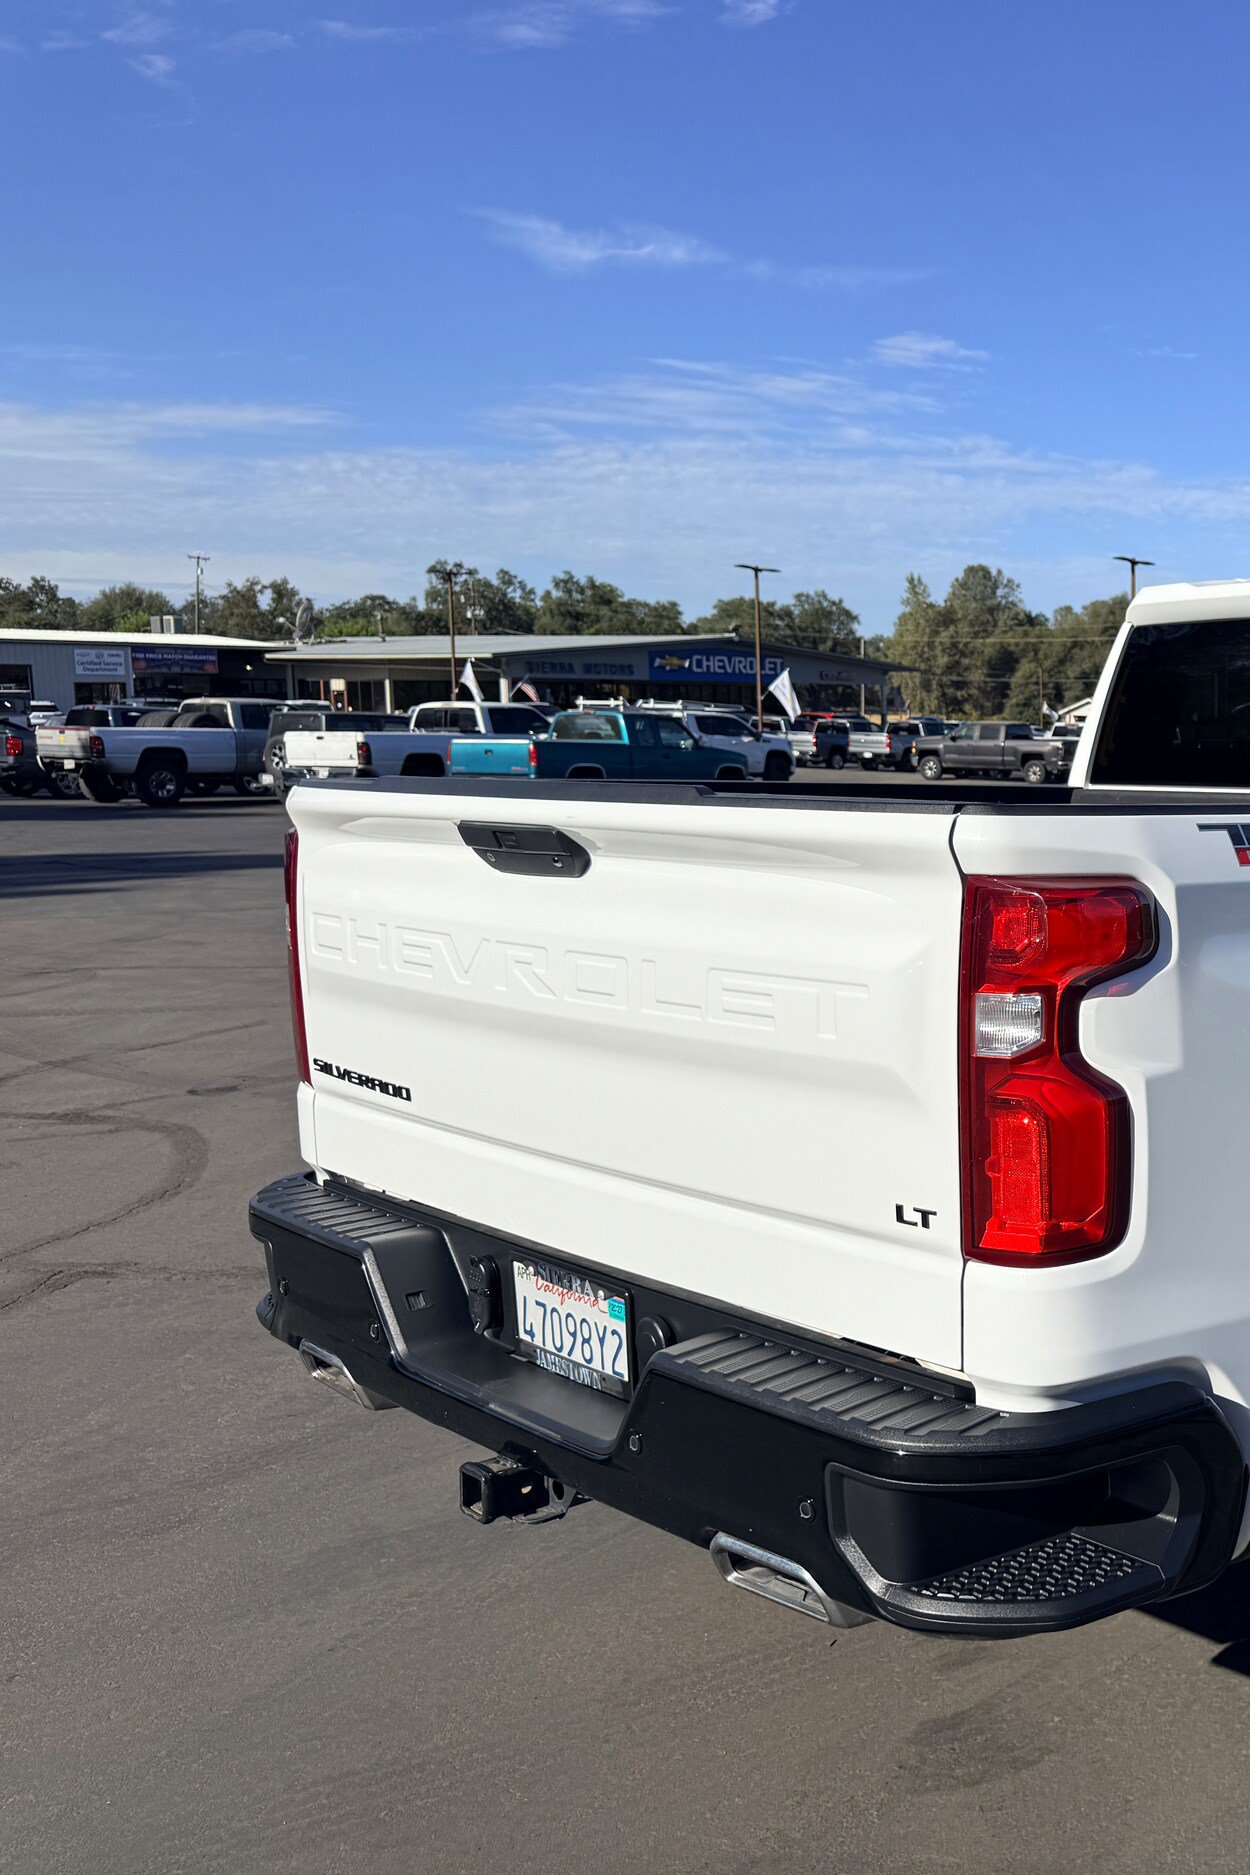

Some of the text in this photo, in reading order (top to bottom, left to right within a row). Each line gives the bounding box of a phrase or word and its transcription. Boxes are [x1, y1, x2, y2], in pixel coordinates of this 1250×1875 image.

[76, 659, 102, 667] Certified
[525, 660, 634, 676] SIERRA MOTORS
[309, 909, 871, 1040] CHEVROLET
[313, 1057, 412, 1103] SILVERADO
[895, 1202, 938, 1230] LT
[537, 1262, 595, 1298] SIERRA
[522, 1294, 625, 1379] 47098Y2
[536, 1348, 602, 1391] JAMESTOWN
